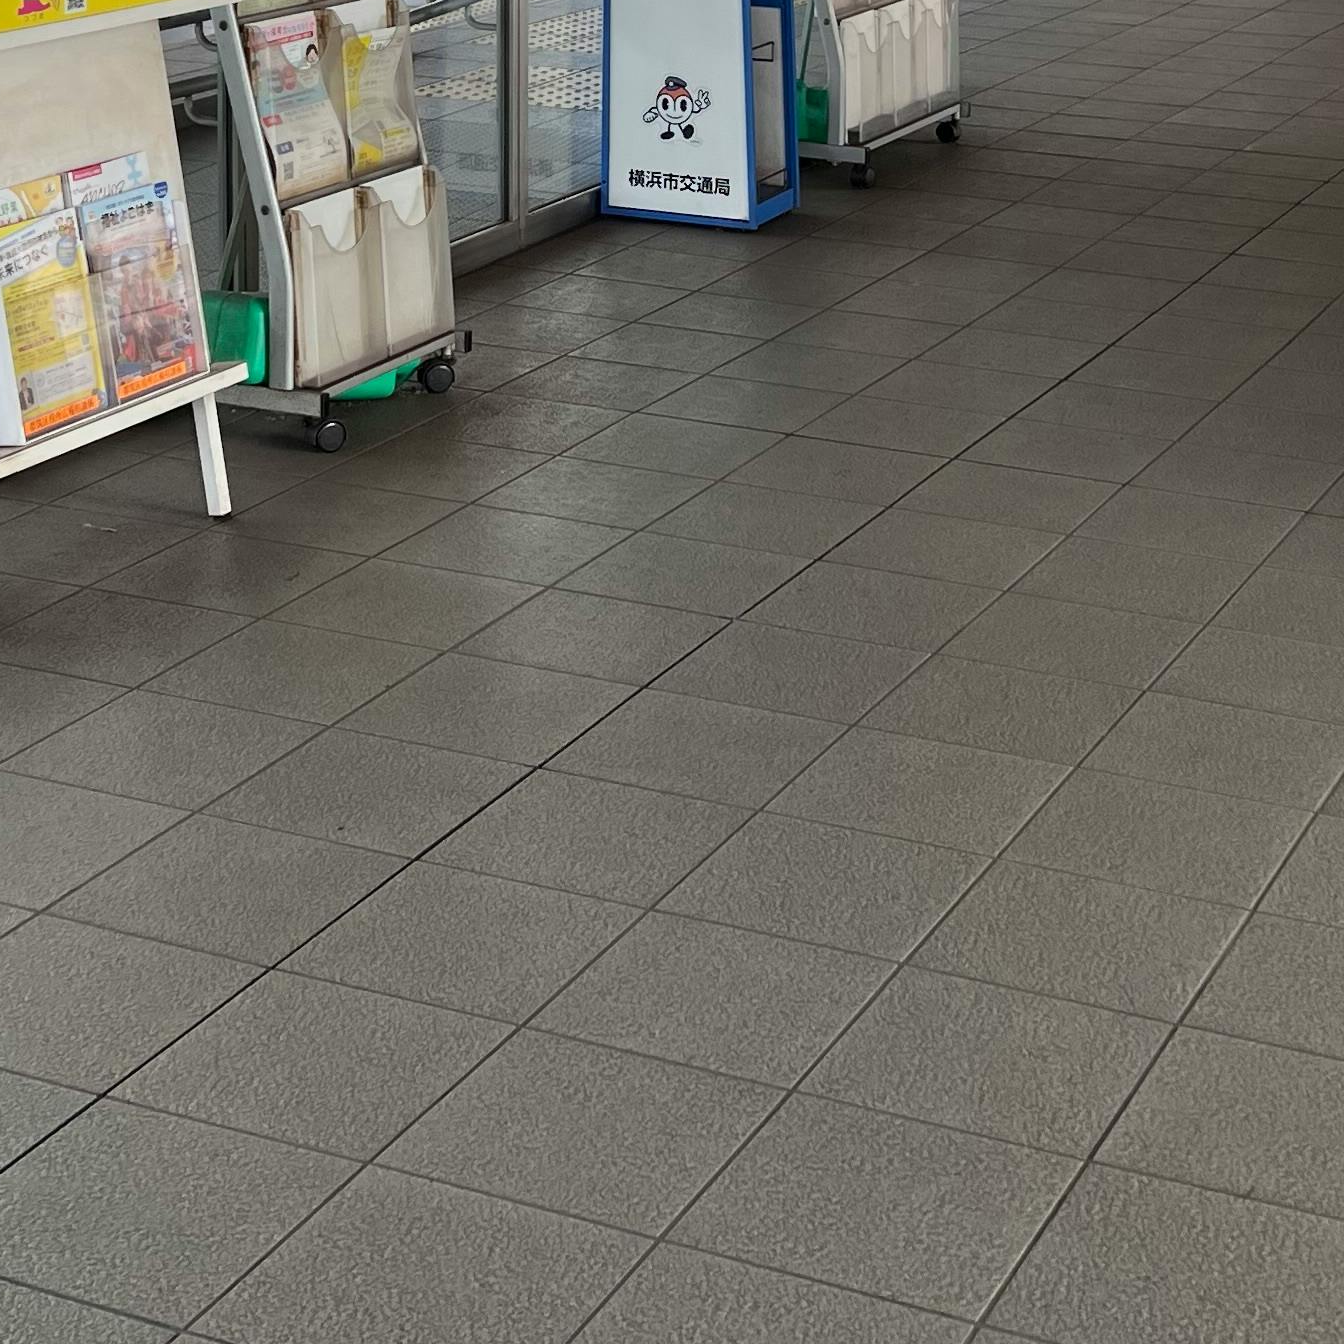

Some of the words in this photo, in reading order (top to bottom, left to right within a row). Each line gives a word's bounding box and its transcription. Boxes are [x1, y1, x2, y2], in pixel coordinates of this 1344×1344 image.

[629, 169, 731, 196] 横浜市交通局
[100, 201, 155, 228] 福祉よこはま
